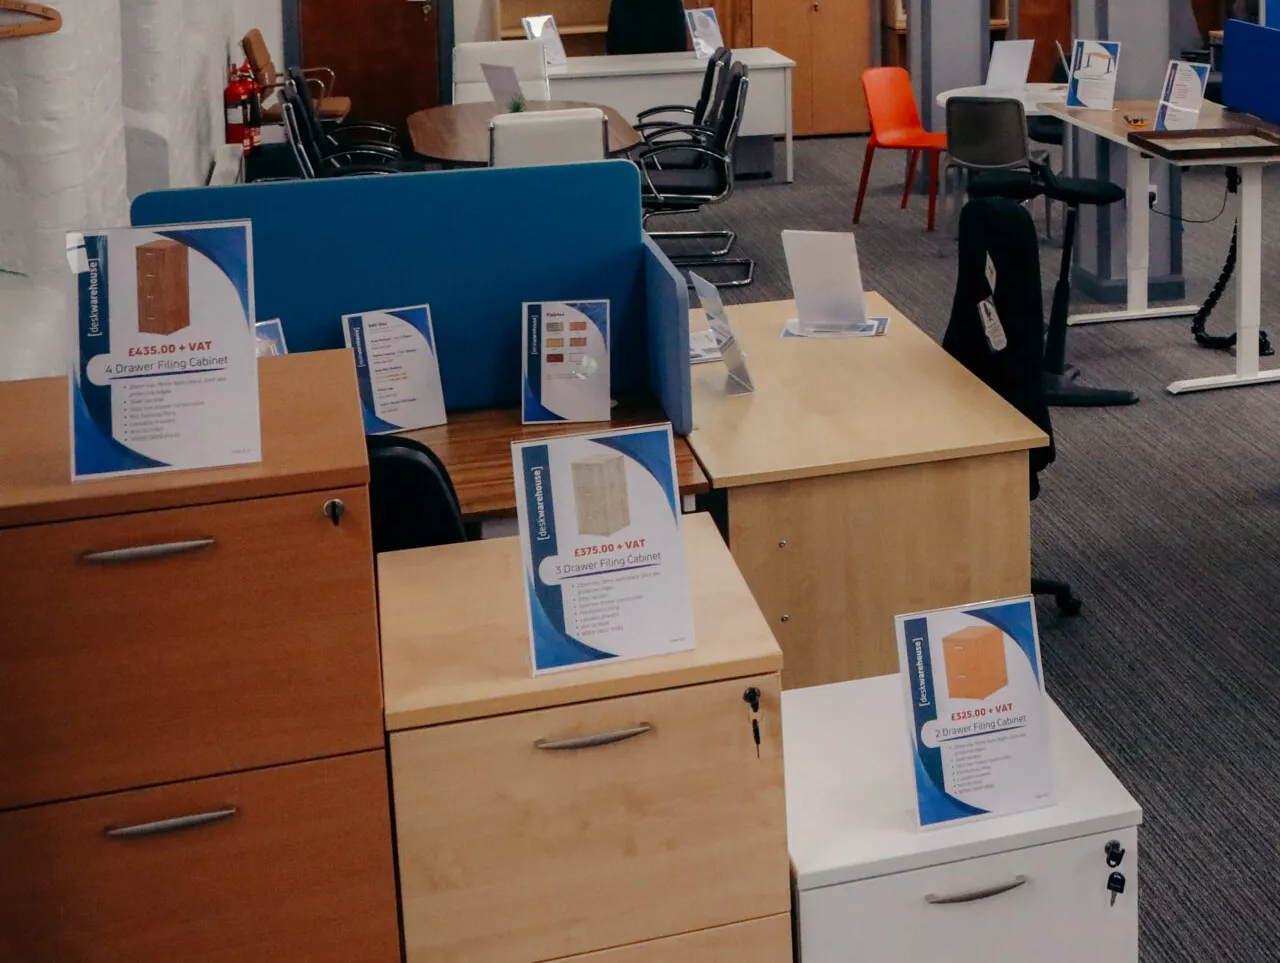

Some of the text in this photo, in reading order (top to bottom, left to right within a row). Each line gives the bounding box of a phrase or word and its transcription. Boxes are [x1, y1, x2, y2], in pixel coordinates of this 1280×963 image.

[128, 344, 176, 357] £435.00
[188, 341, 213, 352] VAT
[105, 356, 229, 374] 4 Drawer Filing Cabinet
[574, 543, 614, 557] £375.00
[624, 539, 646, 550] VAT
[554, 552, 662, 575] 3 Drawer Filing Cabinet
[951, 708, 986, 721] £325.00
[995, 703, 1013, 713] VAT
[935, 715, 1027, 738] 2 Drawer Filing Cabinet
